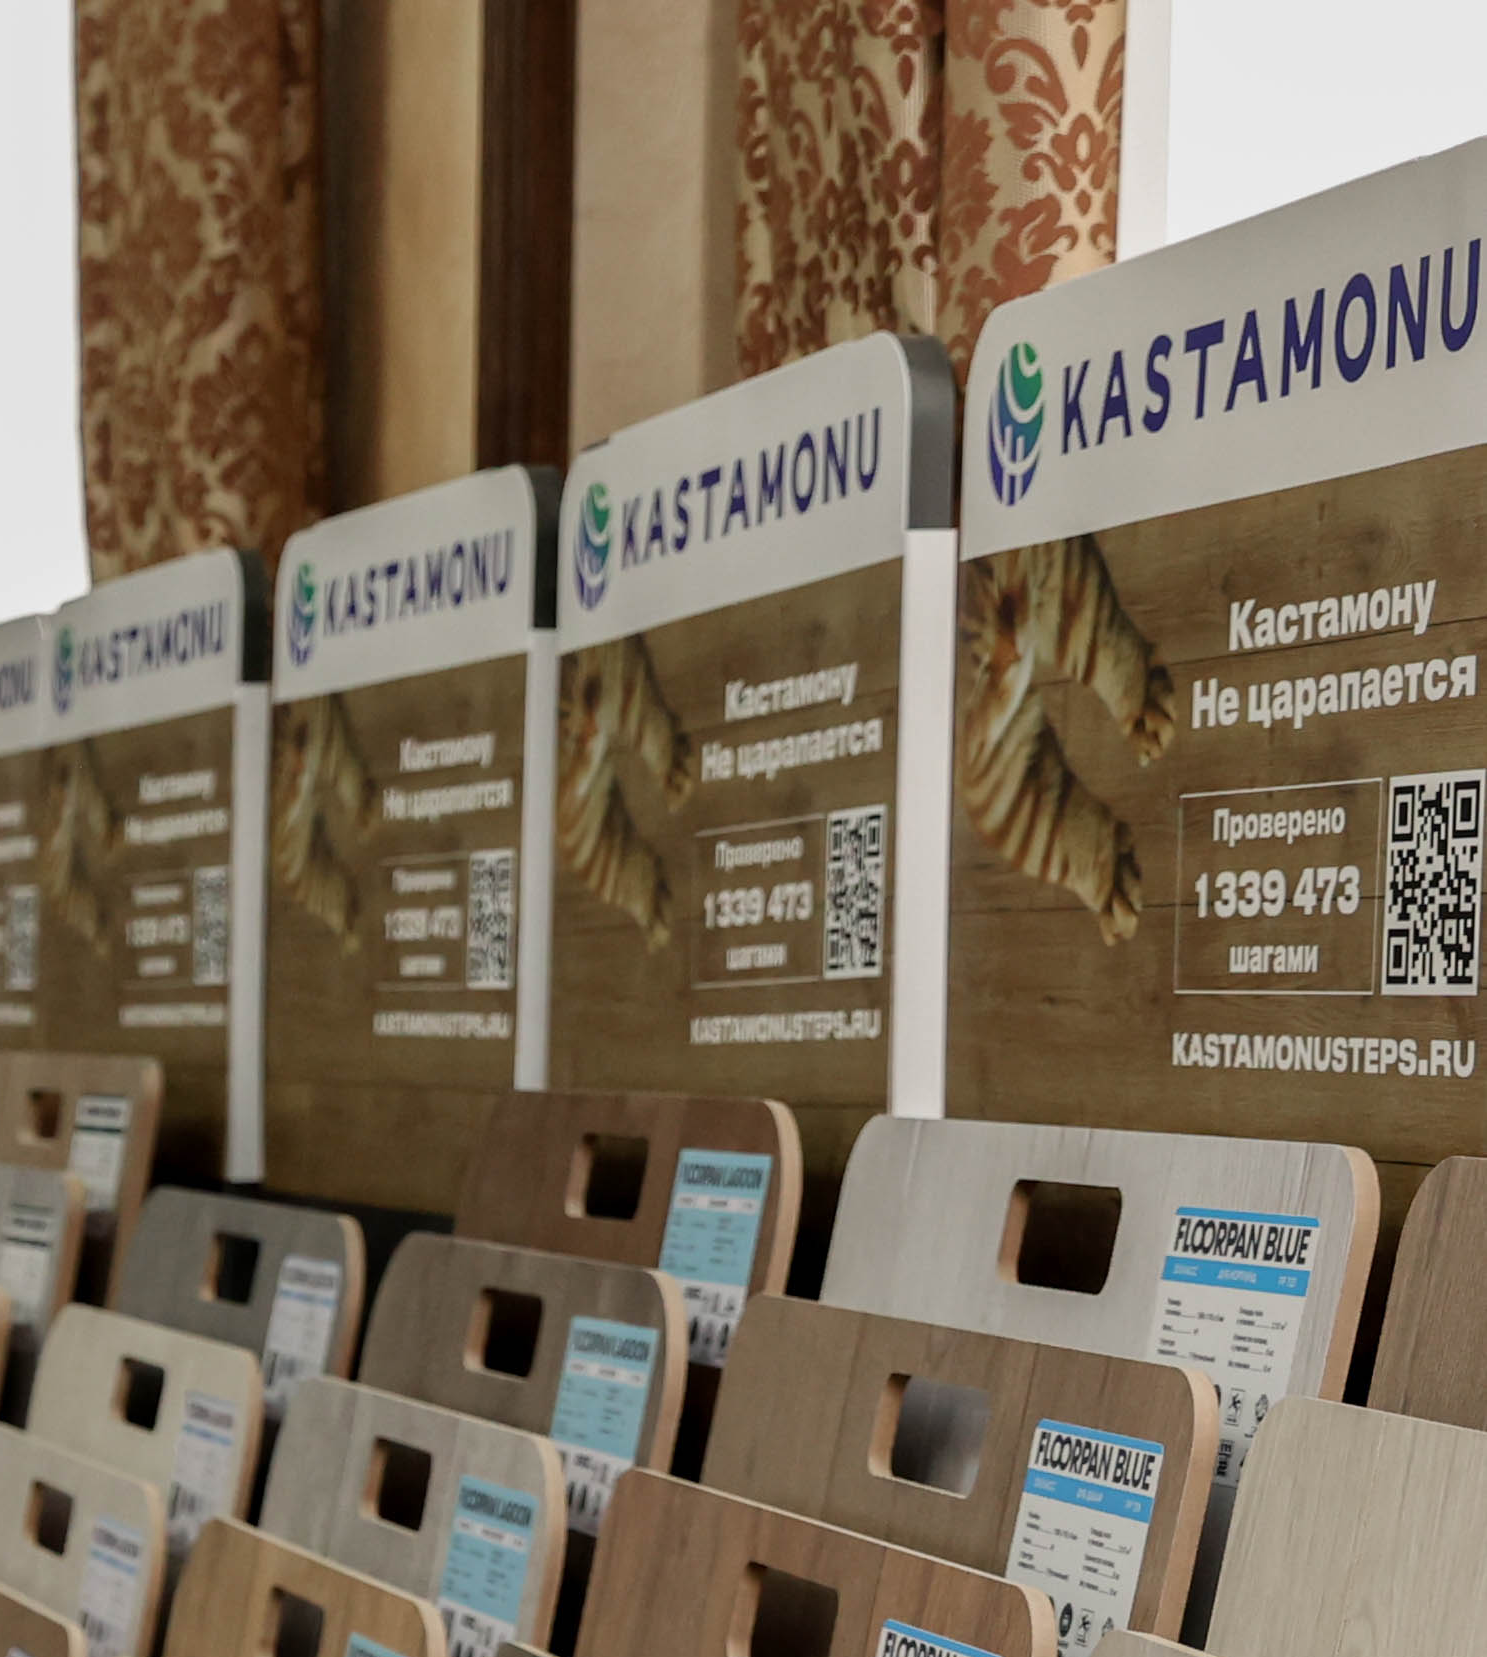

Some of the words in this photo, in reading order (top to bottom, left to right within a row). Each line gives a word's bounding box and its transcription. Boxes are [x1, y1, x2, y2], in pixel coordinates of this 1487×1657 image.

[1061, 238, 1481, 454] KASTAMONU
[621, 407, 880, 570] KASTAMONU
[323, 529, 514, 635] KASTAMONU
[1229, 579, 1436, 651] Кастамону
[725, 661, 858, 721] Кастамону
[1192, 678, 1240, 729] Не
[1247, 655, 1477, 730] царапается
[701, 740, 735, 783] Не
[1213, 807, 1346, 848] Проверено
[767, 880, 814, 923] 473
[1293, 865, 1360, 916] 473
[1229, 945, 1319, 974] шагами
[1172, 1032, 1477, 1078] KASTAMONUSTEPS.RU
[1174, 1218, 1264, 1260] FLOORPAN
[1263, 1226, 1312, 1264] BLUE
[1034, 1431, 1114, 1480] FLOORPAN
[1113, 1448, 1156, 1490] BLUE
